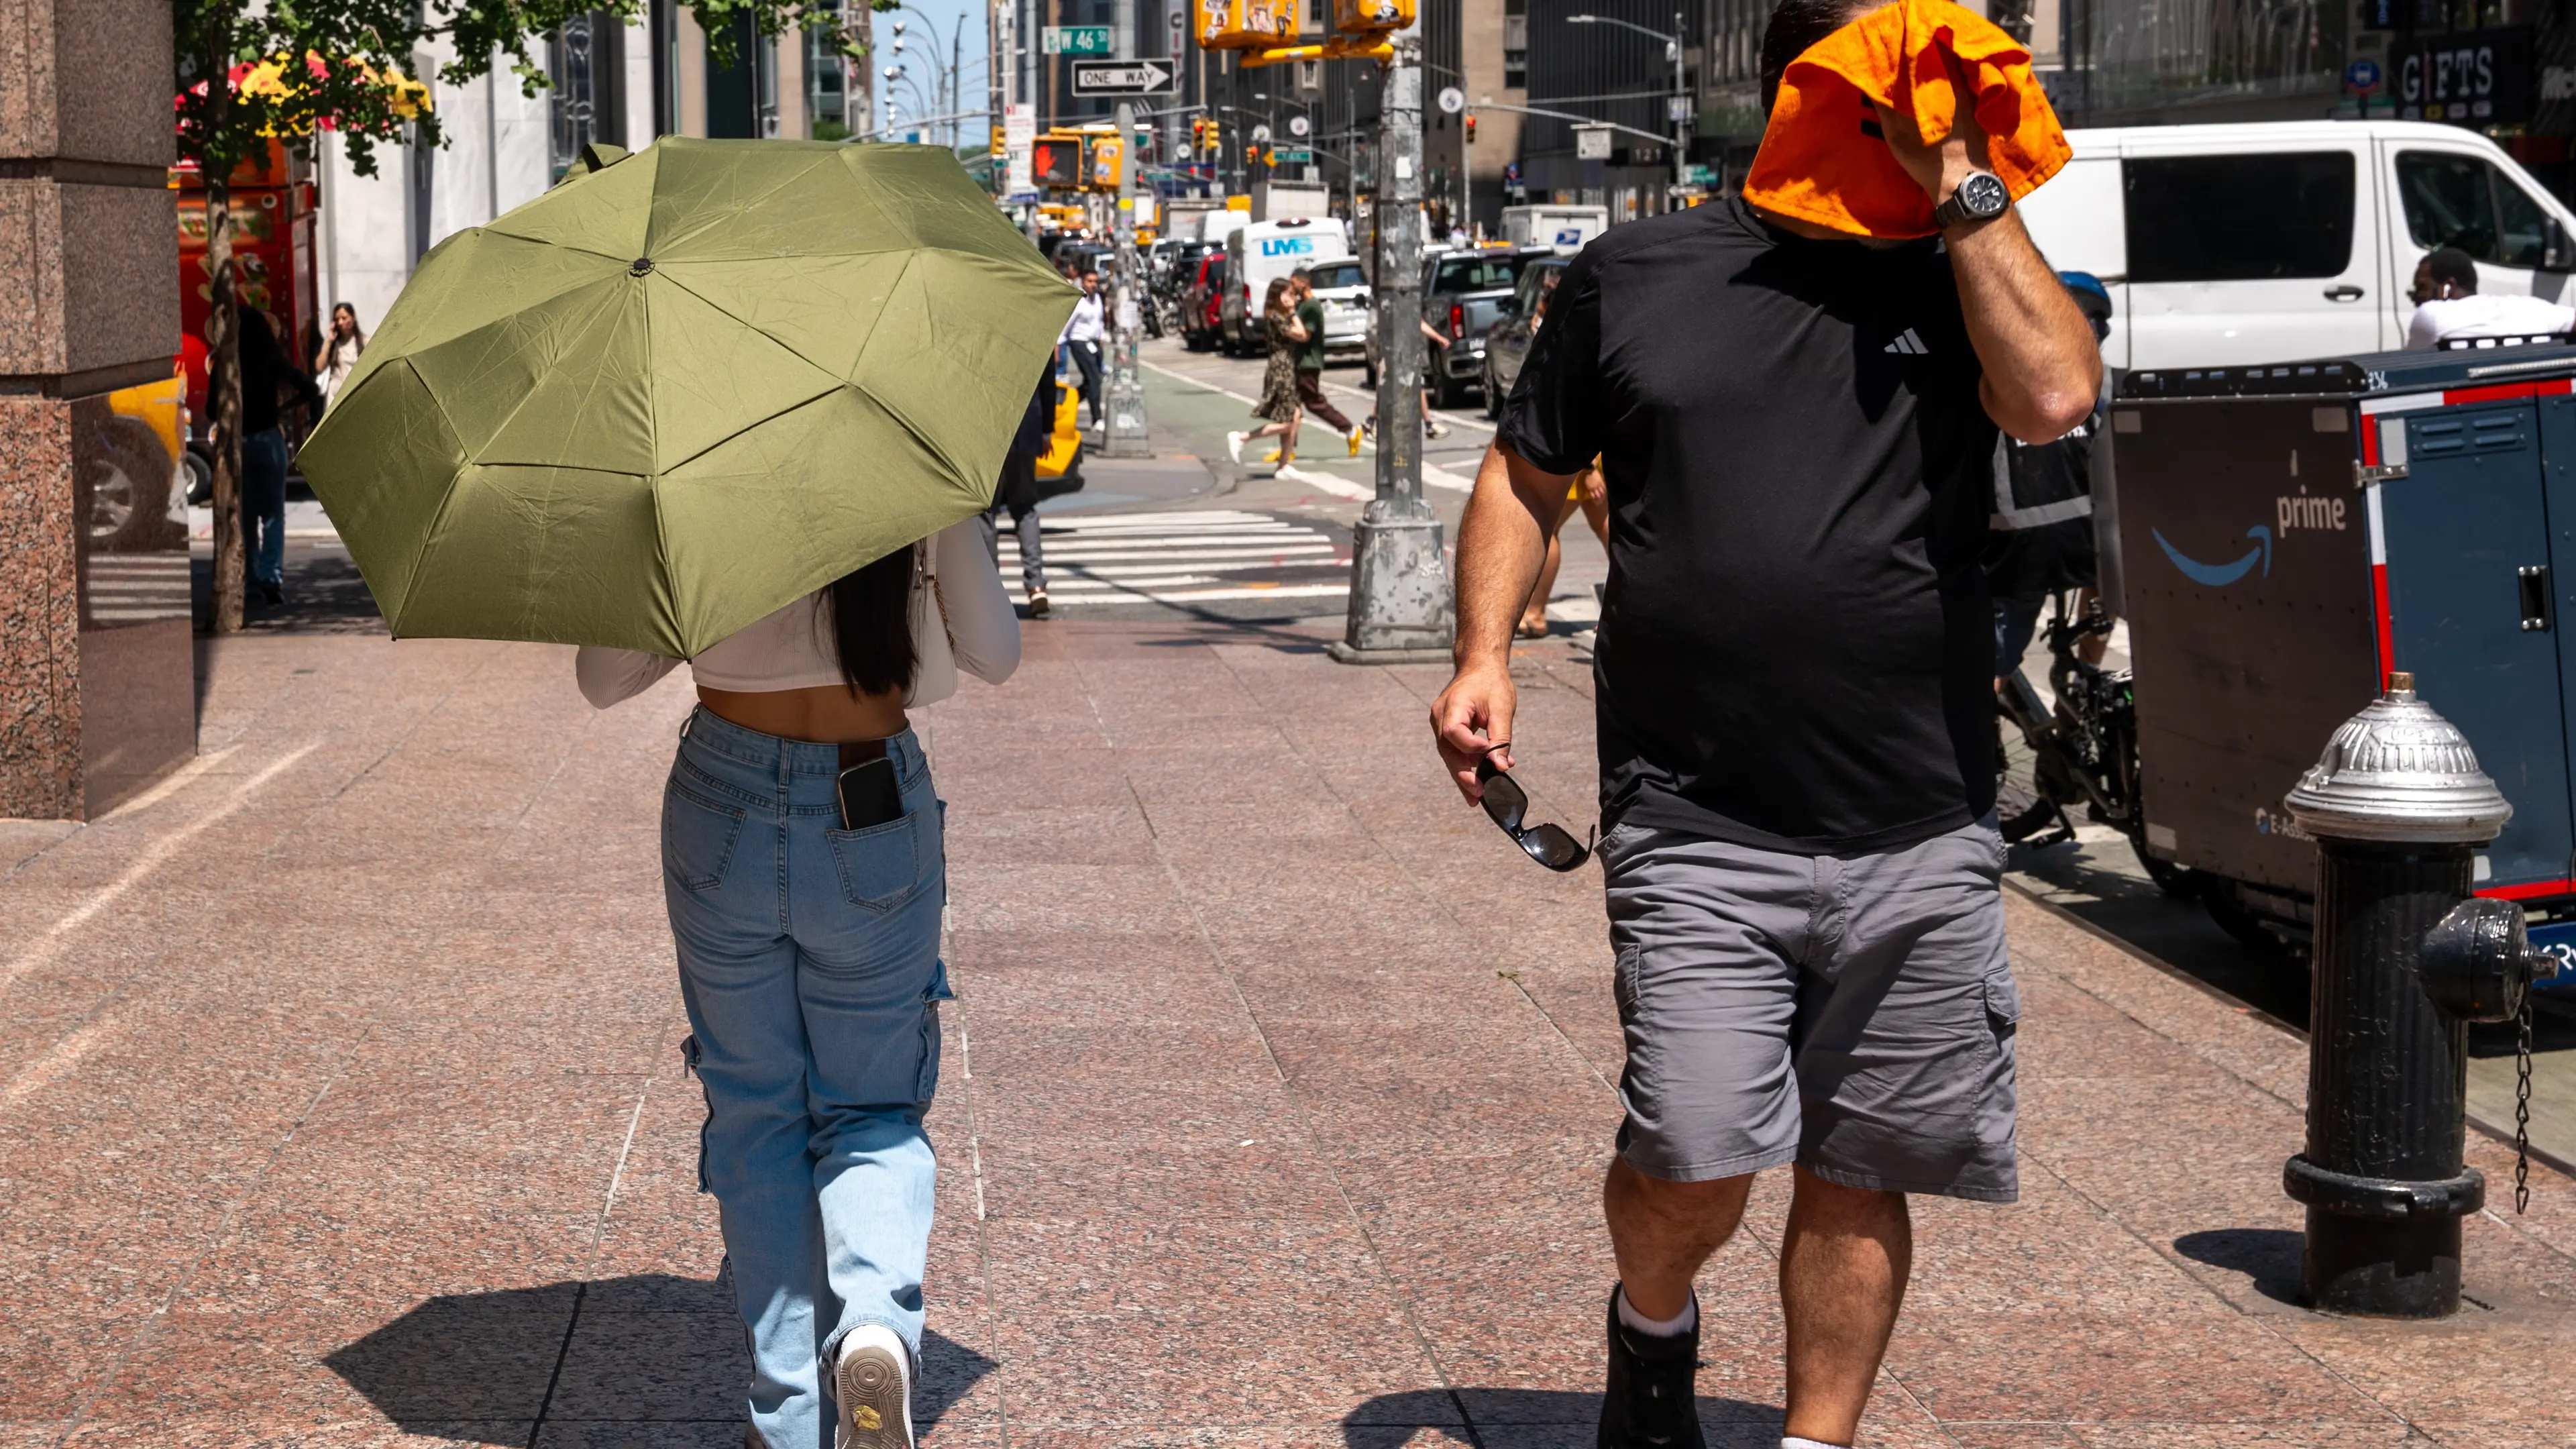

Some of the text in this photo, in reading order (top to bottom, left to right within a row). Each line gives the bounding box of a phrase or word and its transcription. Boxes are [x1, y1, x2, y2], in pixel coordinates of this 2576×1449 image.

[1061, 31, 1072, 50] W
[1076, 30, 1094, 50] 46
[1084, 70, 1154, 85] ONE WAY
[2402, 46, 2493, 101] GIFTS
[1635, 148, 1661, 161] 121
[1263, 237, 1313, 256] LMS
[2277, 484, 2347, 539] prime
